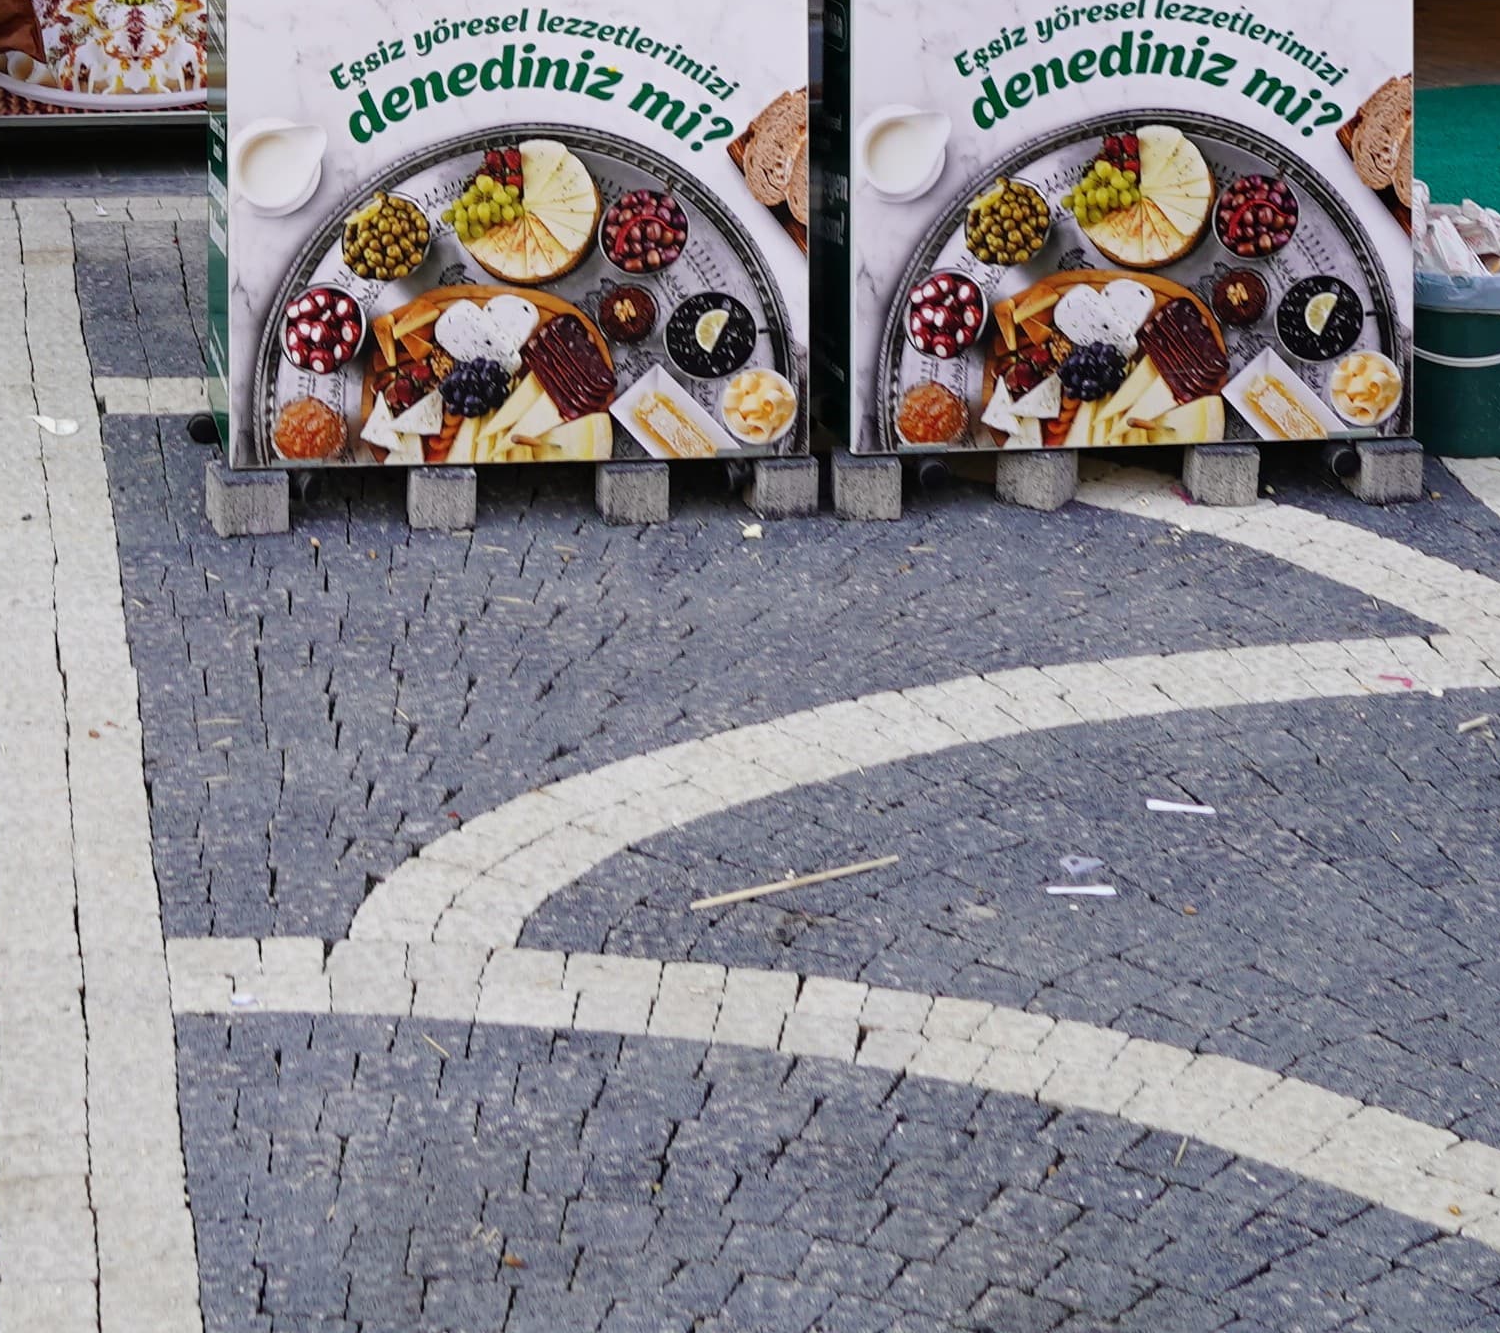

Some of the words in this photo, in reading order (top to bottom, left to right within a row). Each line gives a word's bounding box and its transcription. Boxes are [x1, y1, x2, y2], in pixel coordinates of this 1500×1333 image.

[329, 39, 406, 91] Eşsiz
[414, 8, 529, 56] yöresel
[537, 8, 741, 101] lezzetlerimizi
[348, 43, 625, 143] denediniz
[628, 81, 735, 152] mi?
[953, 24, 1028, 78] Eşsiz
[972, 29, 1238, 130] denediniz
[1241, 68, 1343, 137] mi?
